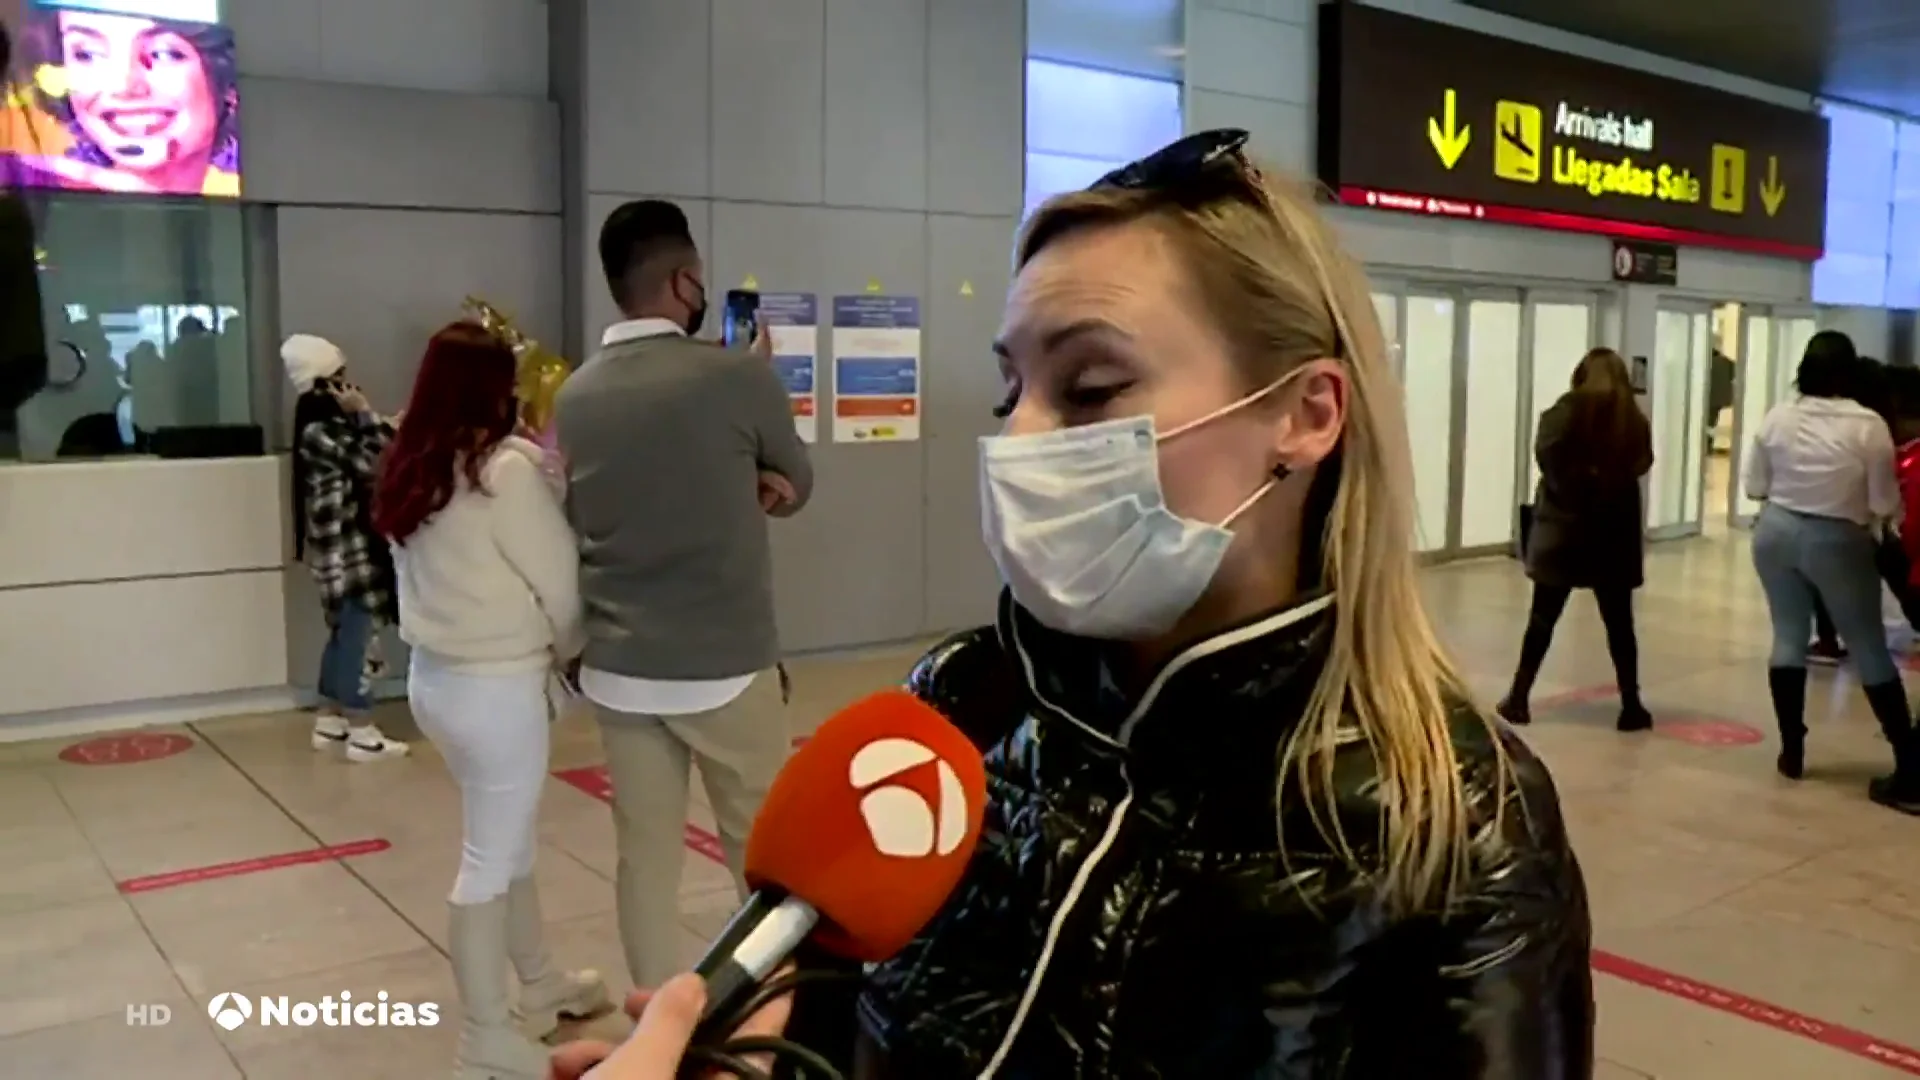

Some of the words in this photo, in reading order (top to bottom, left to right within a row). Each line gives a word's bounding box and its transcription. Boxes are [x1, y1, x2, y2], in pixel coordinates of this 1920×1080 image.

[1554, 100, 1622, 146] Arrivals
[1623, 115, 1654, 151] hall
[1552, 144, 1655, 196] Llegadas
[1656, 163, 1700, 203] Sala
